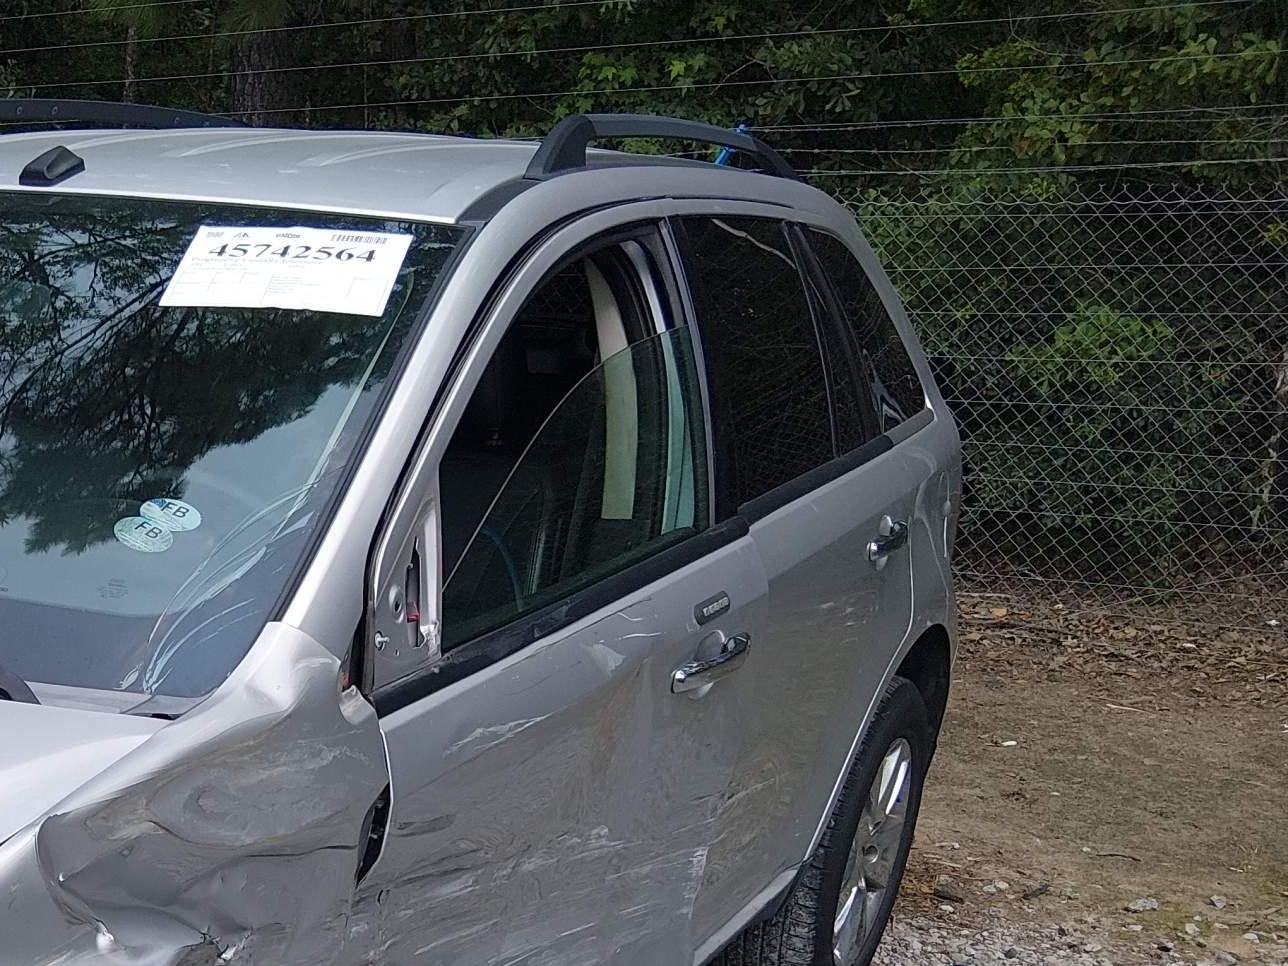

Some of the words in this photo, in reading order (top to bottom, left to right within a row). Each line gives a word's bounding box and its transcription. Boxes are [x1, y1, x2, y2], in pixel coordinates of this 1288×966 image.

[208, 243, 375, 262] 45742564
[161, 502, 190, 517] FB
[135, 521, 162, 538] FB
